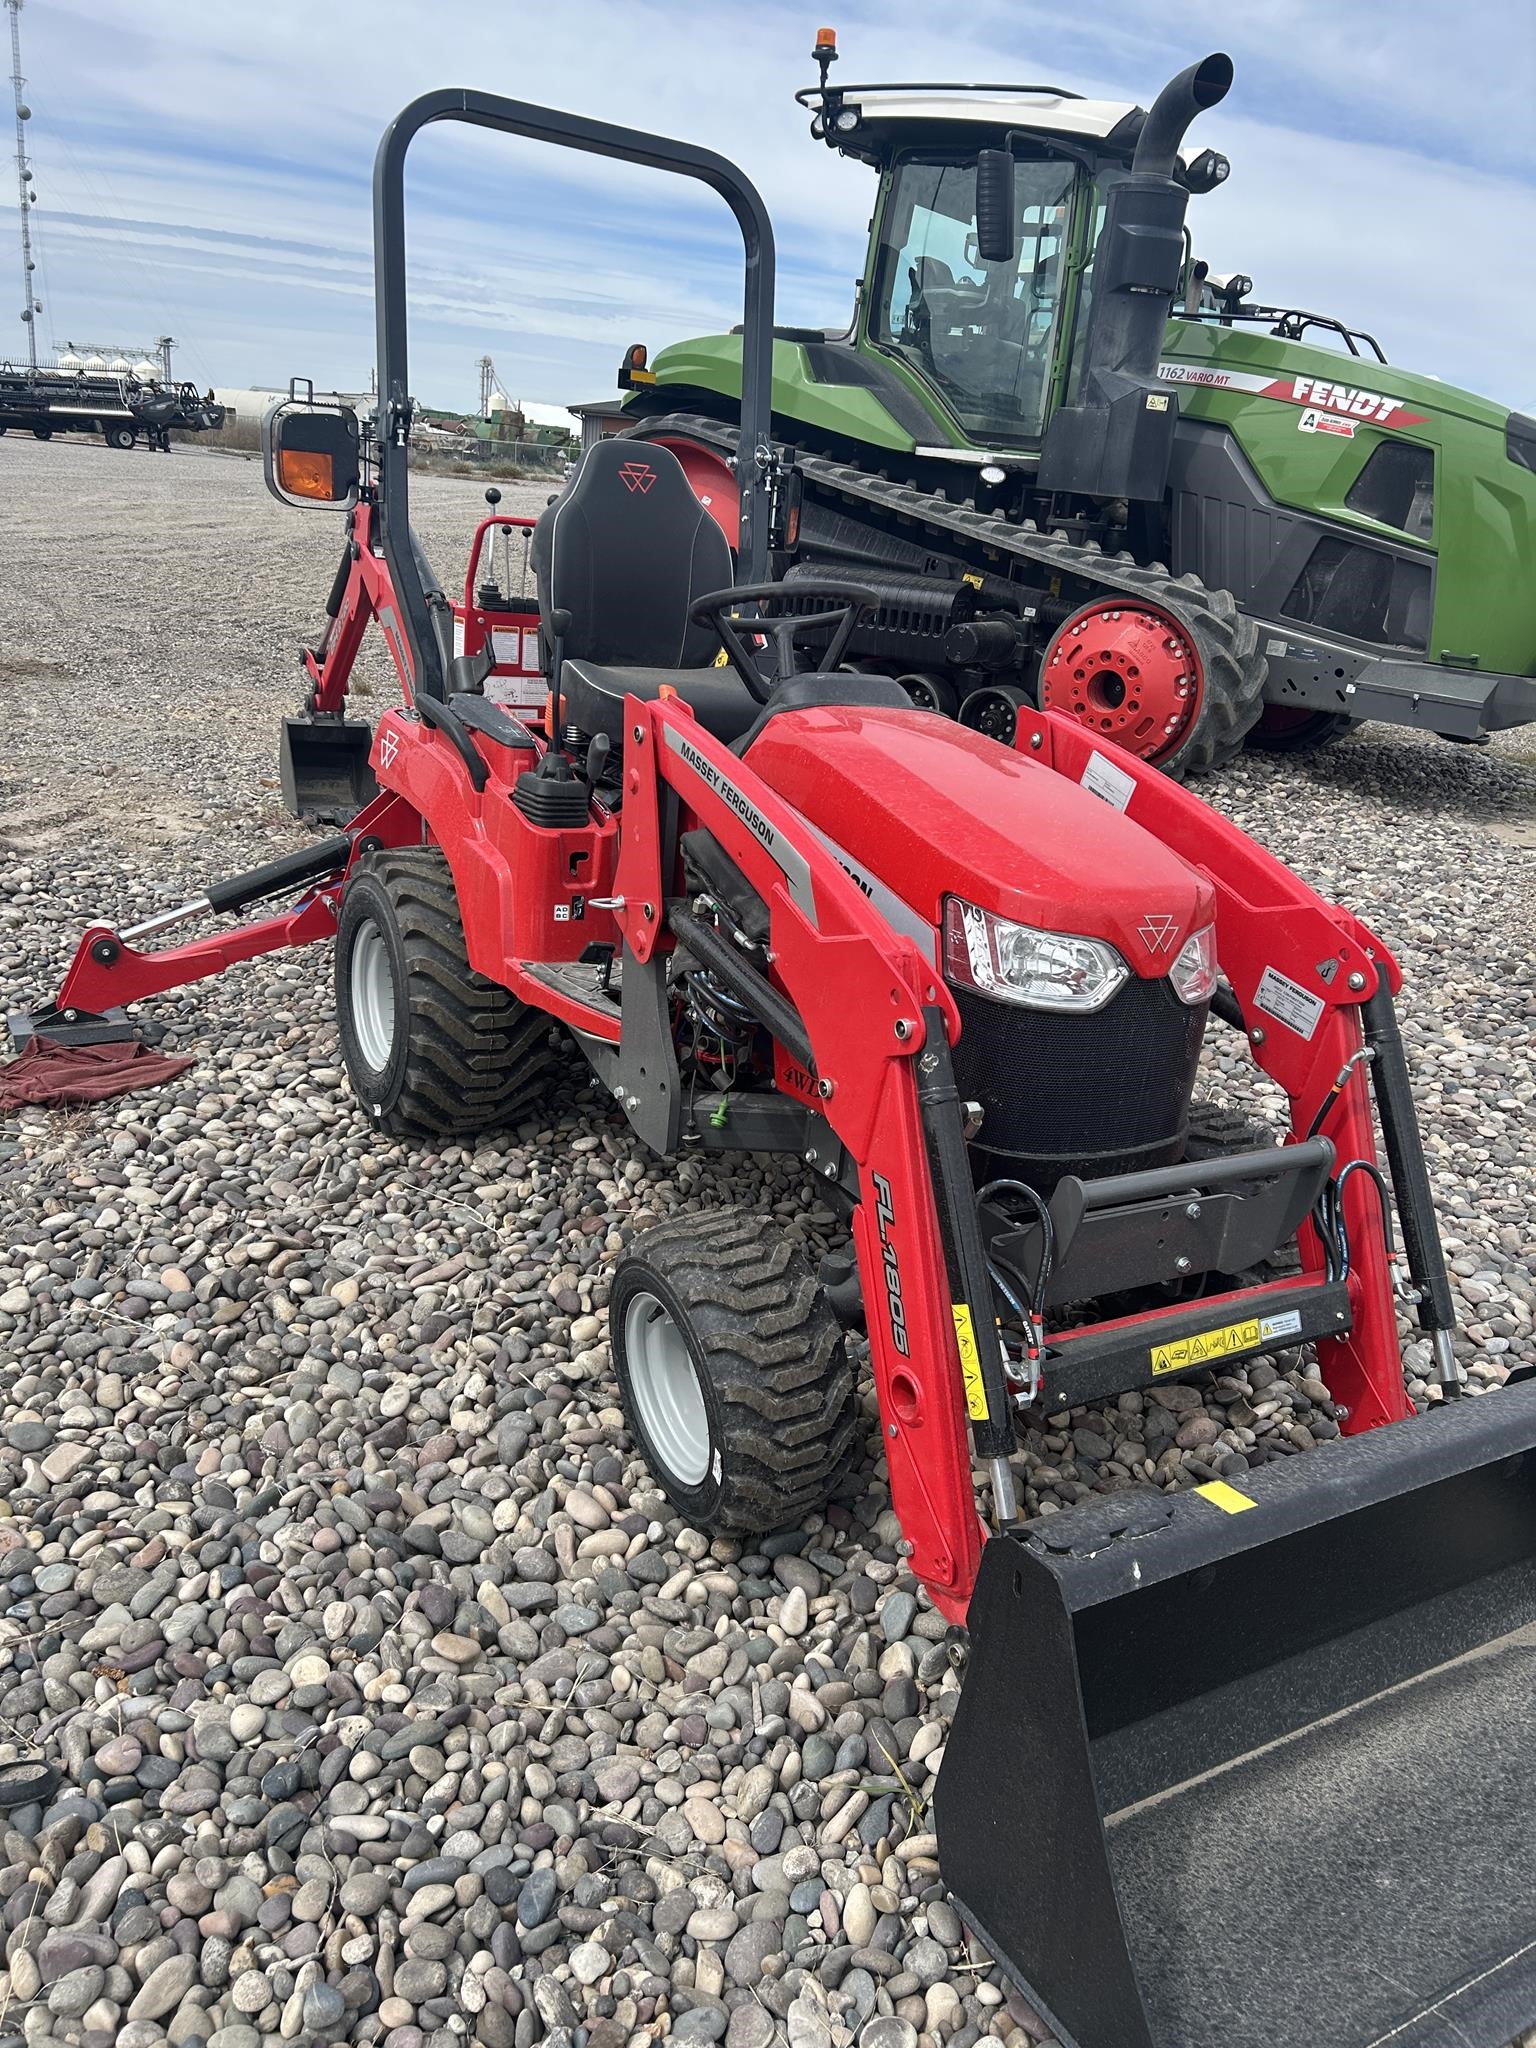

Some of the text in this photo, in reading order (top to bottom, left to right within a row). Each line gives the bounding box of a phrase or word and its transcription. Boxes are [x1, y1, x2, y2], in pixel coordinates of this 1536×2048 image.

[1159, 366, 1231, 386] 1162 VARIO MT
[1291, 376, 1405, 421] FENDT
[680, 742, 774, 846] MASSEY FERGUSON
